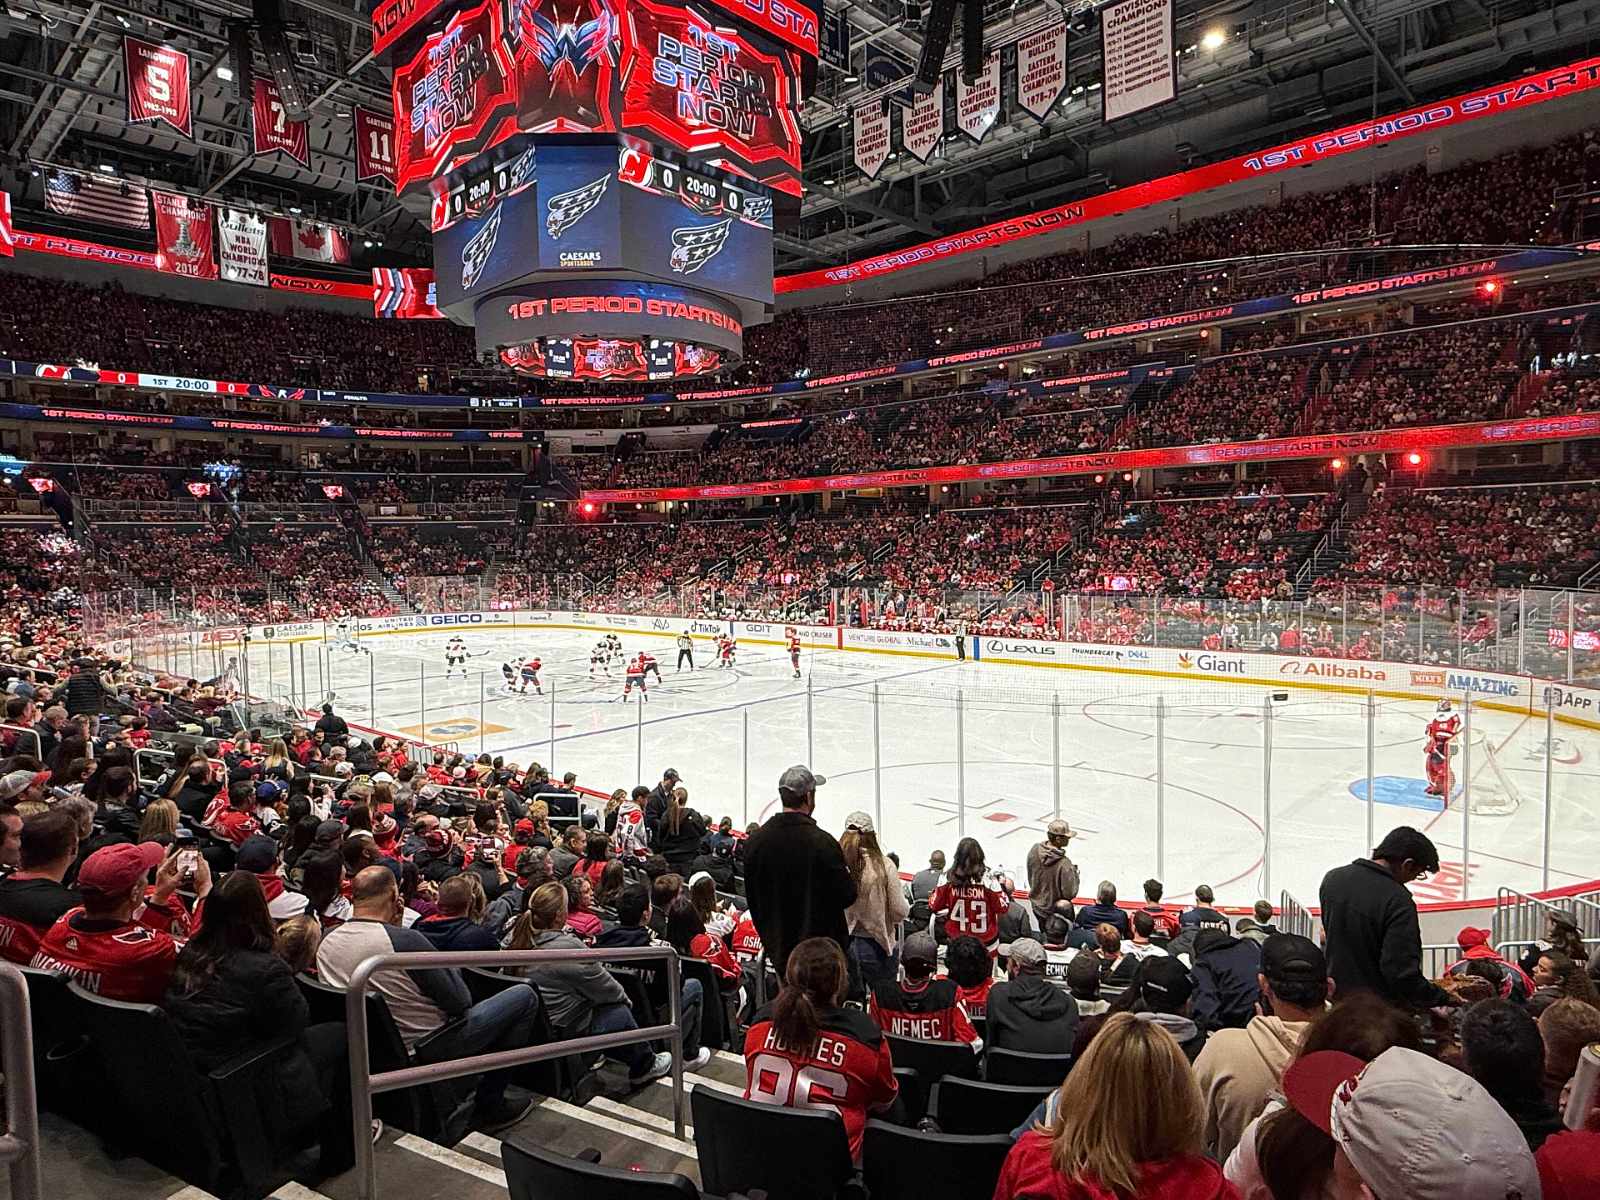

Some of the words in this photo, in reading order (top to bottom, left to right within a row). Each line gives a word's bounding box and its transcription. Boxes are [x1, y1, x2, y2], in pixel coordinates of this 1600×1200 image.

[1107, 0, 1168, 29] CHAMPIONS
[429, 25, 462, 60] 1ST
[688, 22, 740, 61] 1ST
[1019, 24, 1066, 52] WASHINGTON
[1028, 40, 1056, 58] BULLETS
[412, 33, 482, 108] PERIOD
[658, 33, 765, 93] PERIOD
[1021, 61, 1063, 84] CONFERENCE
[1028, 53, 1056, 72] EASTERN
[966, 80, 991, 97] EASTERN
[1022, 71, 1062, 93] CHAMPIONS
[960, 87, 997, 109] CONFERENCE
[961, 98, 995, 117] CHAMPIONS
[425, 82, 476, 149] NOW
[678, 91, 756, 138] NOW
[906, 109, 940, 129] CONFERENCE
[912, 103, 934, 118] EASTERN
[906, 119, 939, 137] CHAMPIONS
[370, 131, 391, 162] 11
[857, 130, 888, 148] CONFERENCE
[857, 139, 887, 156] CHAMPIONS
[1243, 145, 1306, 171] 1ST
[1313, 106, 1454, 155] PERIOD
[470, 180, 490, 202] 20:00
[663, 169, 673, 189] 0
[687, 176, 717, 198] 20:00
[729, 192, 738, 210] 0
[161, 206, 206, 222] CHAMPIONS
[46, 240, 156, 267] PERIOD
[230, 243, 258, 255] WORLD
[824, 269, 861, 282] 1ST
[863, 246, 933, 273] PERIOD
[935, 223, 1019, 254] STARTS
[1021, 206, 1086, 231] NOW
[559, 252, 601, 261] CAESARS
[175, 262, 199, 276] 2018
[271, 277, 336, 291] NOW
[1291, 290, 1321, 304] 1ST
[1322, 281, 1379, 300] PERIOD
[1381, 270, 1448, 289] STARTS
[509, 299, 548, 320] 1ST
[551, 297, 633, 313] PERIOD
[646, 300, 723, 328] STARTS
[1106, 321, 1150, 337] PERIOD
[1150, 314, 1199, 329] STARTS
[117, 373, 126, 384] 0
[152, 378, 168, 387] 1ST
[175, 378, 209, 391] 20:00
[227, 383, 235, 394] 0
[1336, 436, 1377, 448] NOW
[431, 613, 482, 625] GEICO
[699, 623, 721, 634] TikTok
[746, 624, 772, 634] GDIT
[1006, 645, 1056, 656] LEXUS
[1197, 655, 1246, 674] Giant
[1303, 662, 1386, 682] Alibaba
[1447, 674, 1520, 697] AMAZING
[952, 888, 985, 899] WILSON
[951, 899, 988, 934] 43
[891, 1017, 942, 1039] NEMEC
